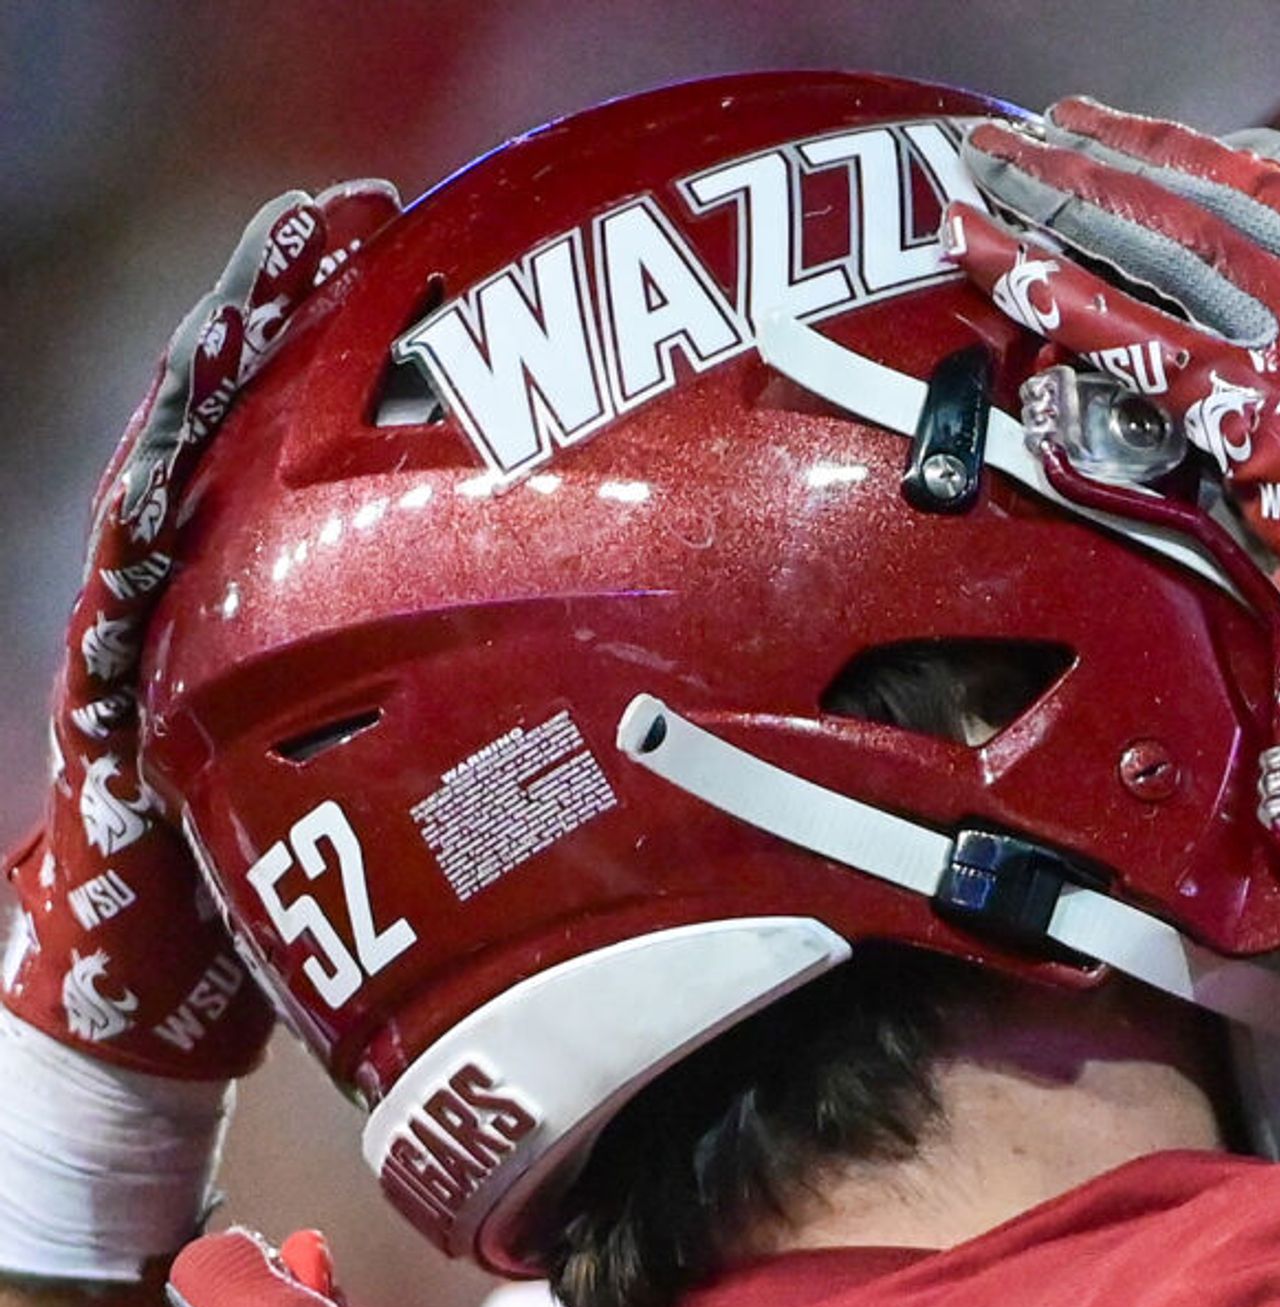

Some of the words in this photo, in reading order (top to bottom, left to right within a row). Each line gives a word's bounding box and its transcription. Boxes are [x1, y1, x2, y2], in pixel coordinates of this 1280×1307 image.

[261, 210, 317, 278] WSU
[99, 552, 172, 600] WSU
[68, 868, 137, 931] WSU
[247, 801, 417, 1010] 52
[153, 953, 246, 1051] WSU
